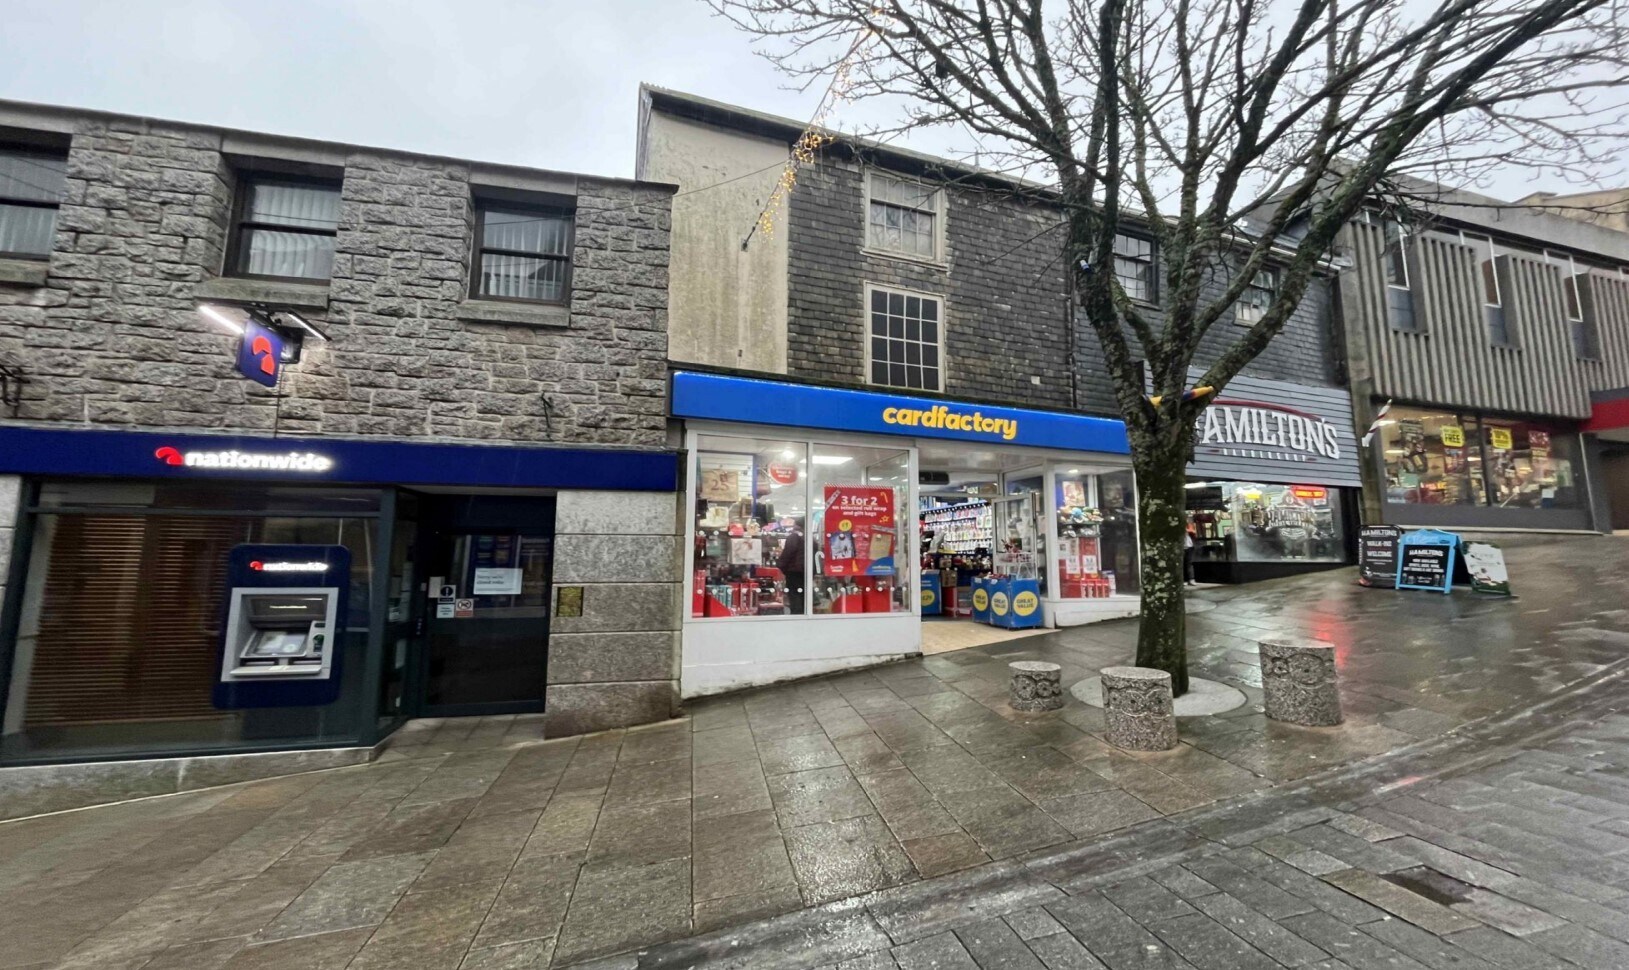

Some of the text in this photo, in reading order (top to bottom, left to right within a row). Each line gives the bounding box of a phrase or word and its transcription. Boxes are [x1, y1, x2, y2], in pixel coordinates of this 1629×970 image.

[883, 405, 1017, 440] cardfactory
[1195, 406, 1340, 459] AMILTON'S
[184, 451, 333, 471] nationwide
[841, 495, 849, 505] 3
[850, 495, 869, 506] for
[870, 496, 878, 506] 2
[263, 561, 328, 571] nationwide
